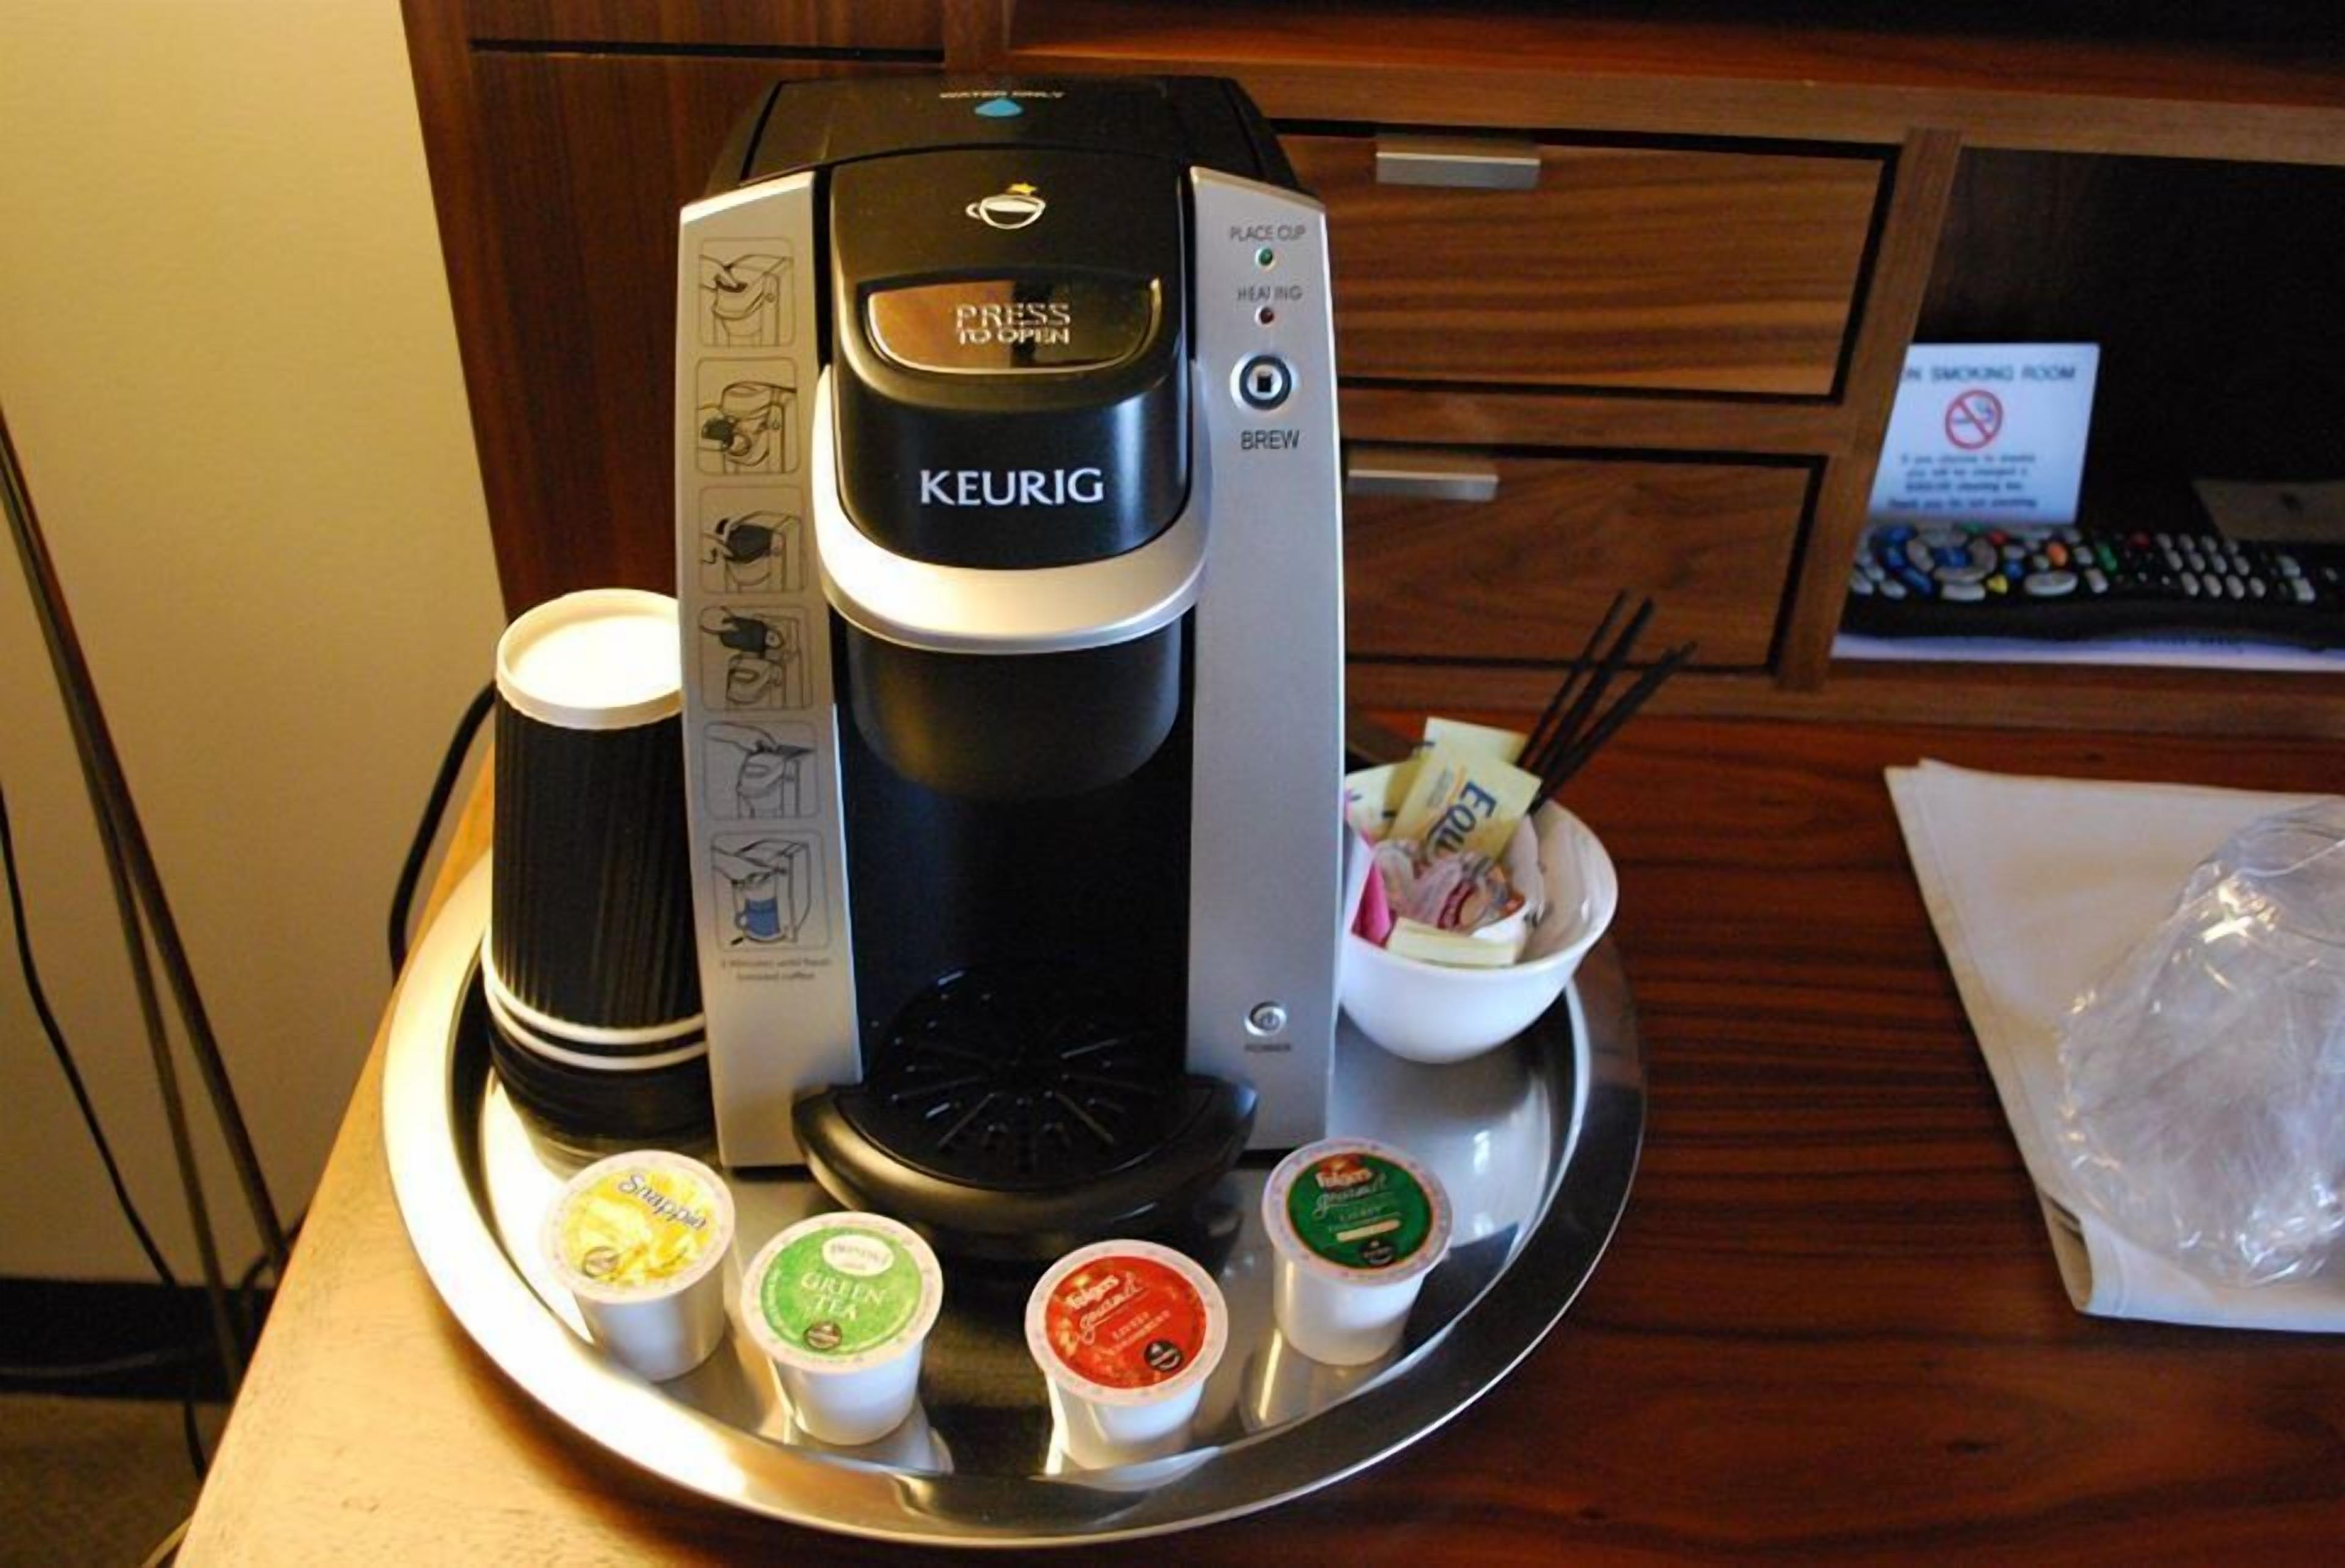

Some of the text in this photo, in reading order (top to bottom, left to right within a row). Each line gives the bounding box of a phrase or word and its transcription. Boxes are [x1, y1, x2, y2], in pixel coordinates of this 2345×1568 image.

[1229, 224, 1307, 241] PLACE CUP
[956, 302, 1071, 329] PRESS
[958, 327, 1070, 345] TO OPEN
[1240, 429, 1300, 450] BREW
[919, 467, 1104, 506] KEURIG
[801, 1272, 886, 1305] GREEN
[809, 1293, 857, 1322] TEA
